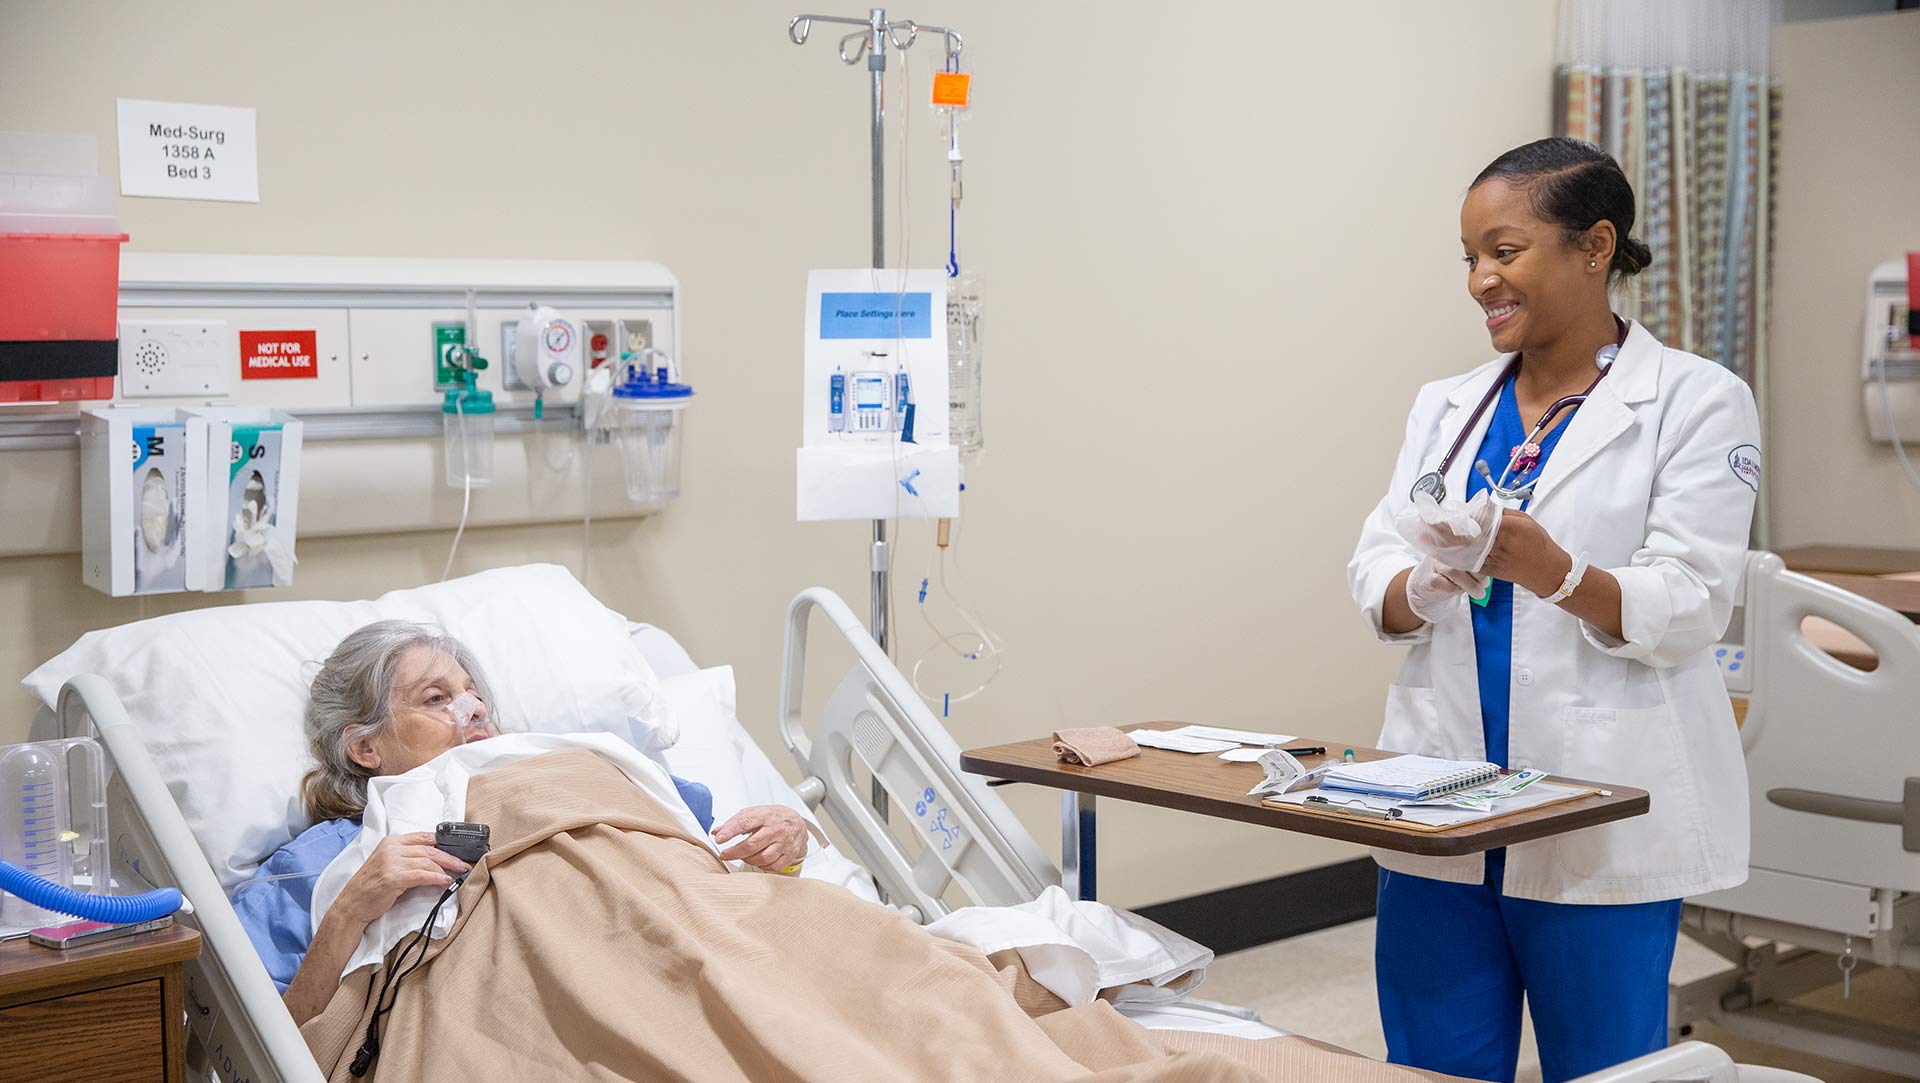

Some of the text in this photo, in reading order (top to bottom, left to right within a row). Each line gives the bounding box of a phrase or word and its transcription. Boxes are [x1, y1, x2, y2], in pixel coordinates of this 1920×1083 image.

[149, 123, 225, 145] Med-Surg
[162, 144, 215, 160] 1358 A
[167, 163, 212, 180] Bed 3
[835, 310, 858, 318] Place
[860, 310, 893, 319] Settings
[257, 341, 301, 355] NOT FOR
[248, 355, 311, 368] MEDICAL USE
[146, 436, 164, 456] M
[248, 444, 265, 459] S
